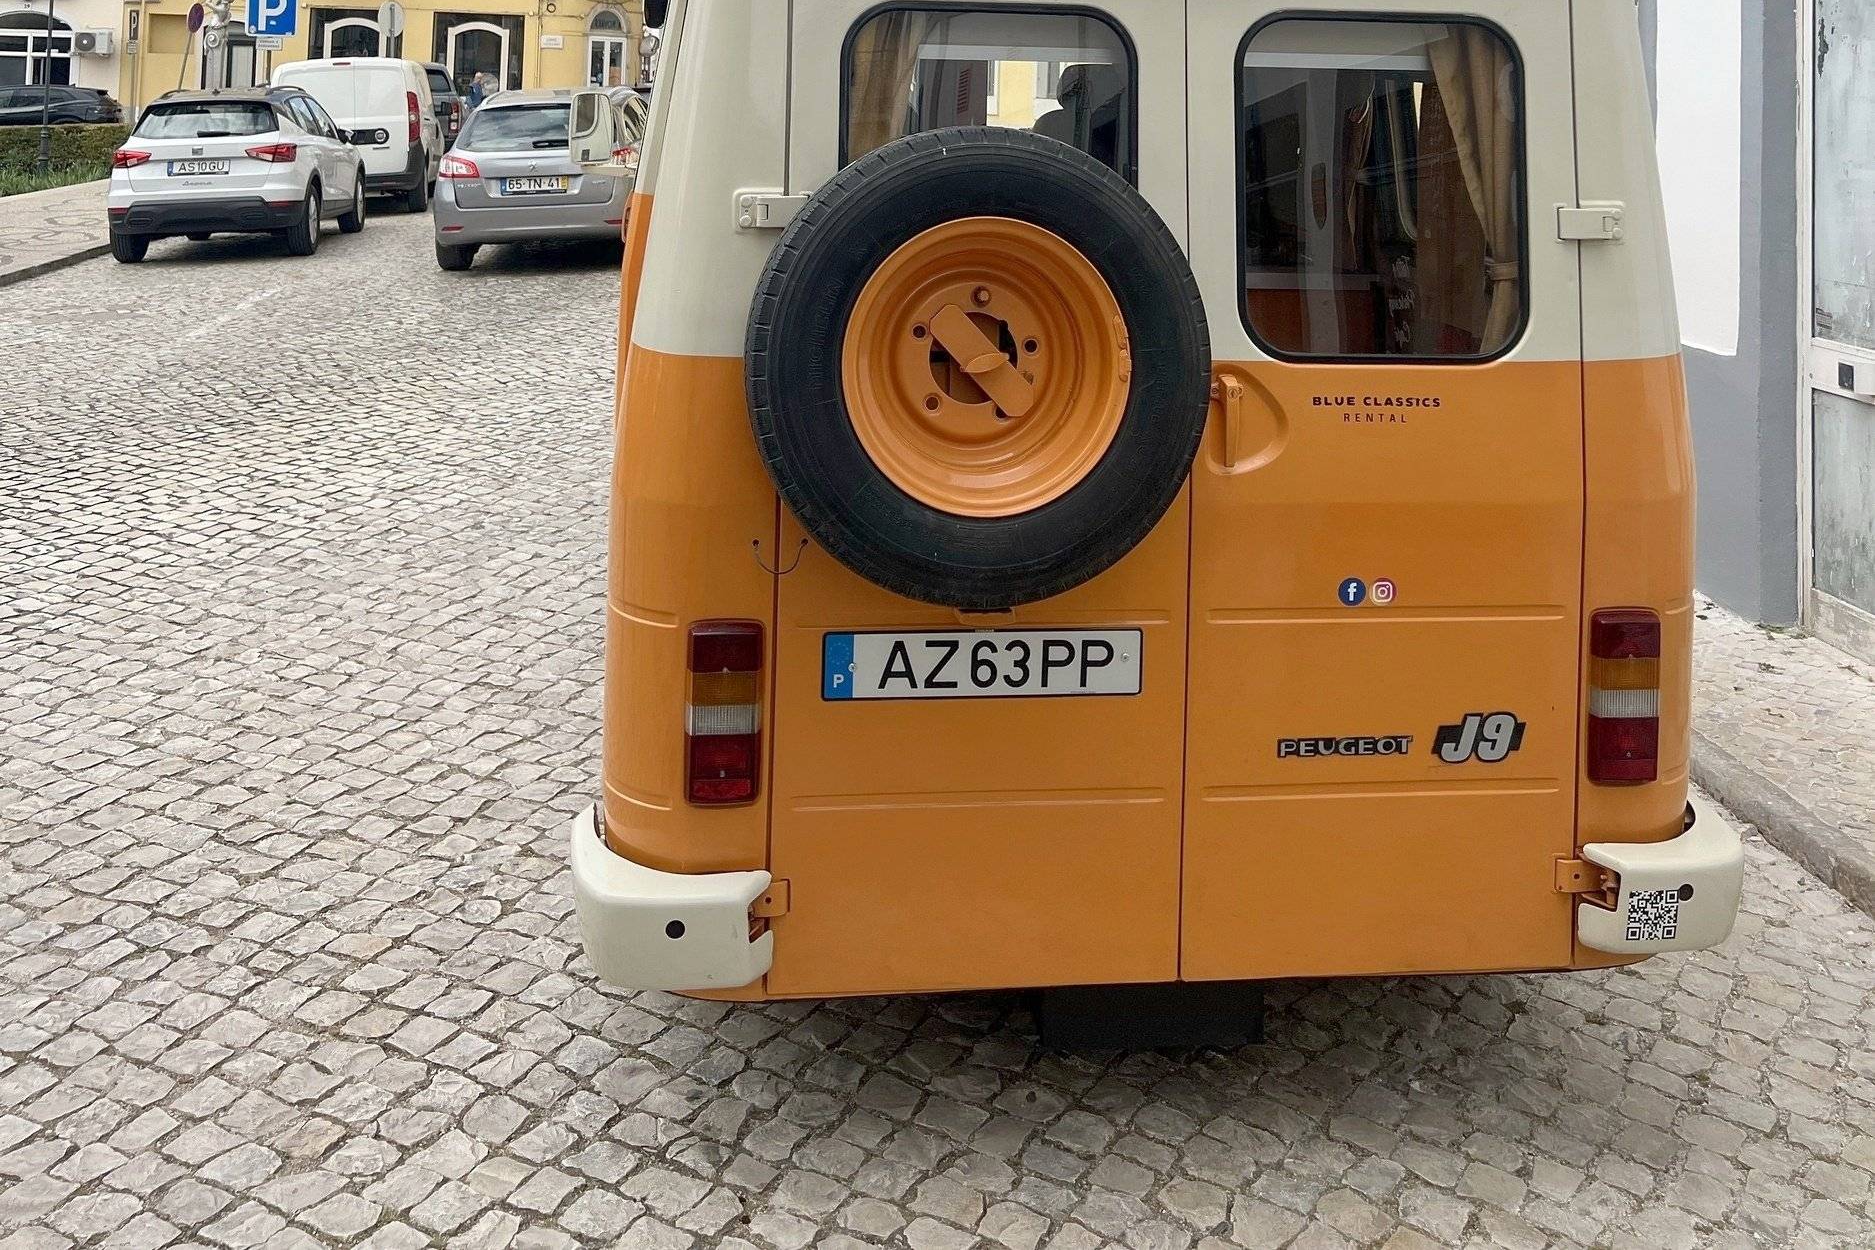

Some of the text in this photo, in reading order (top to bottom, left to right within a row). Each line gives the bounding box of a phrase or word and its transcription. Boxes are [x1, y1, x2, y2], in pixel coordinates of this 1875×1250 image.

[1312, 396, 1441, 408] BLUE CLASSICS
[1343, 412, 1408, 423] RENTAL
[832, 674, 844, 688] P
[1278, 714, 1516, 763] PEUGEOT J9
